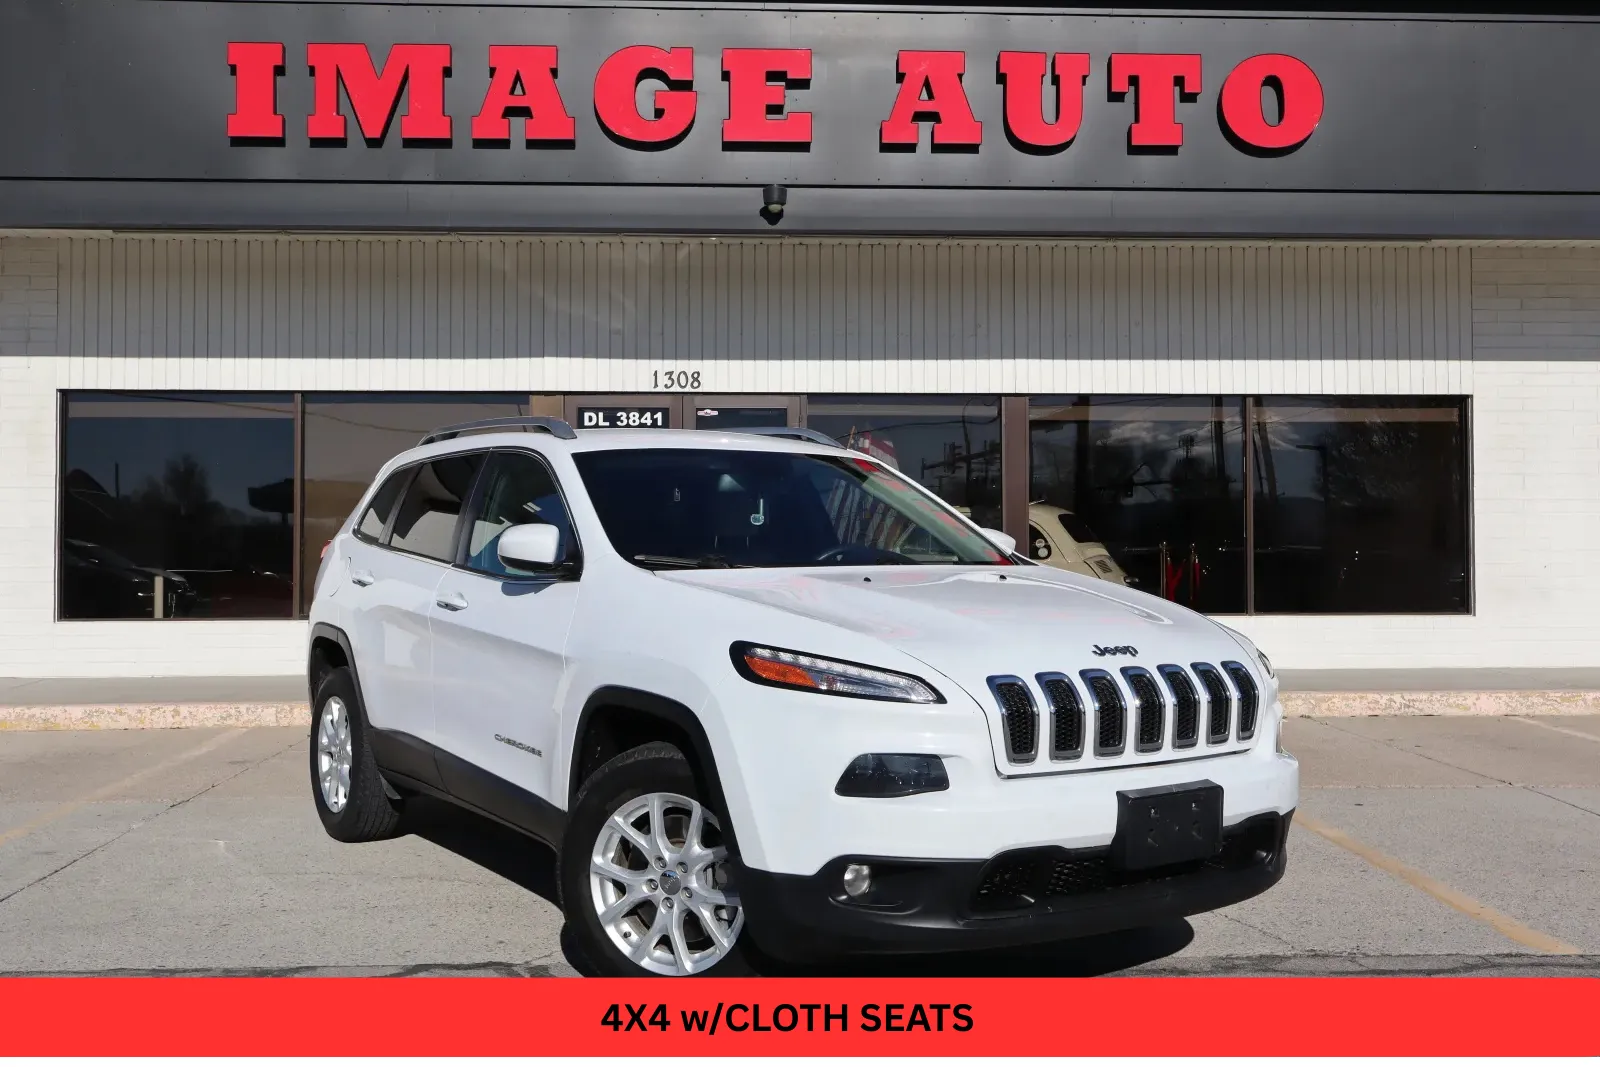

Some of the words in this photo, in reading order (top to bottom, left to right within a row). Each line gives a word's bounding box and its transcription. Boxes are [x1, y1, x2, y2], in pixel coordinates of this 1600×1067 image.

[227, 42, 812, 144] IMAGE
[880, 50, 1325, 150] AUTO
[652, 369, 702, 390] 1308
[583, 411, 610, 427] DL
[616, 411, 663, 427] 3841
[1091, 644, 1139, 658] Jeep
